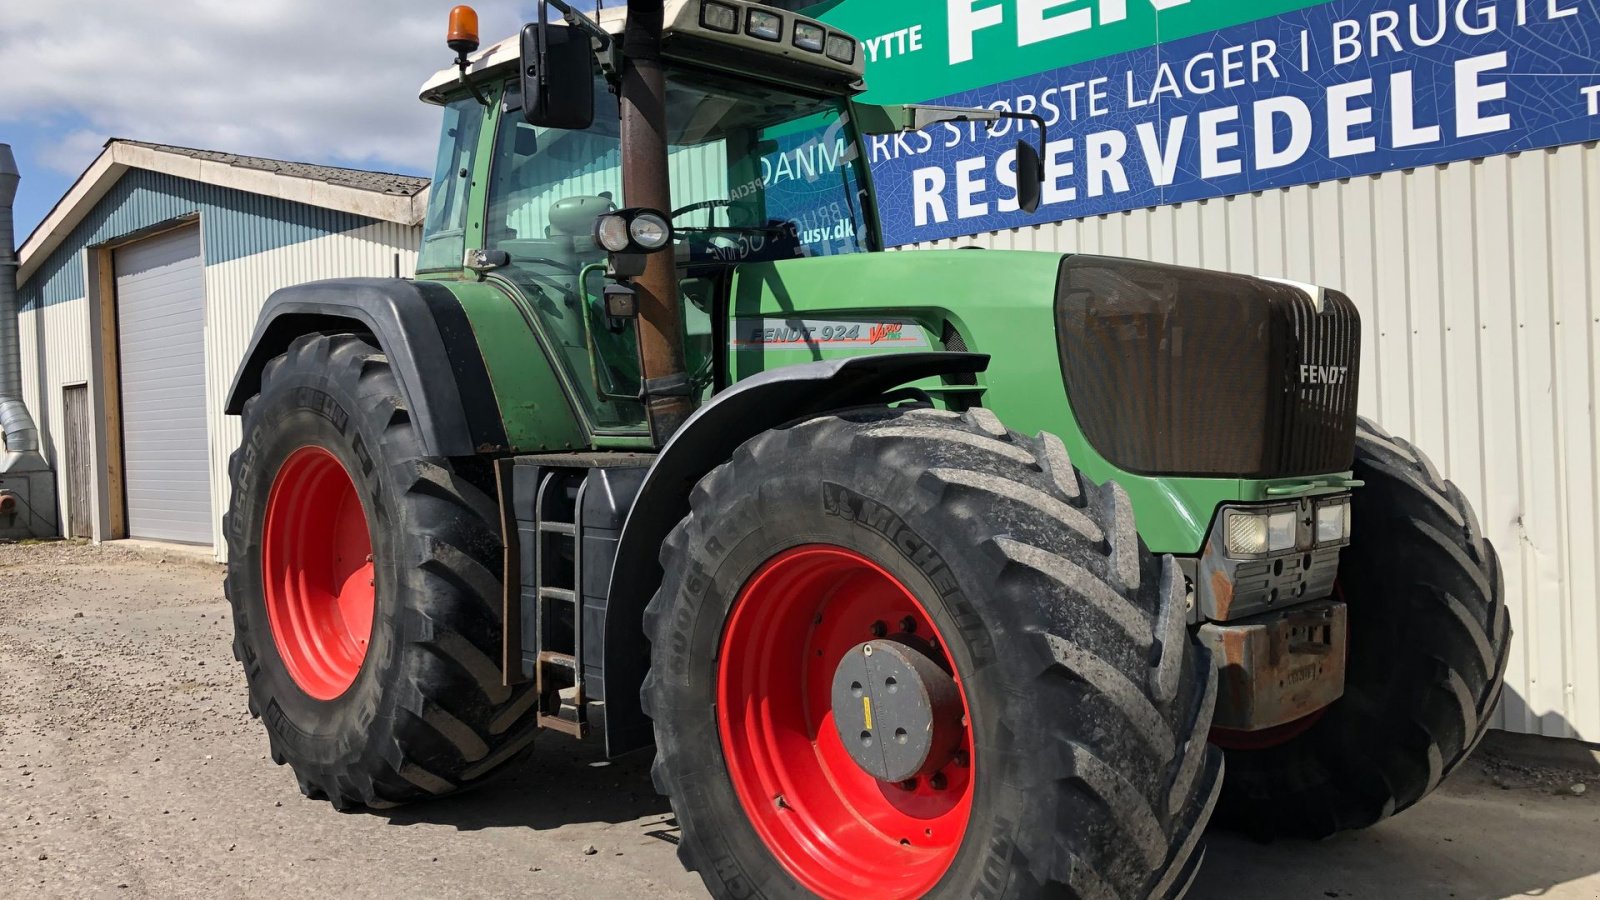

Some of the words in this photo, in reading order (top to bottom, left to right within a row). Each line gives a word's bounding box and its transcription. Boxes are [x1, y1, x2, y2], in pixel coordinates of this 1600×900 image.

[860, 24, 923, 63] YTTE
[1127, 38, 1281, 108] LAGER
[1301, 30, 1309, 72] I
[912, 50, 1511, 227] RESERVEDELE
[750, 326, 817, 343] FENDT
[821, 324, 860, 341] 924
[1300, 364, 1348, 385] FENDT
